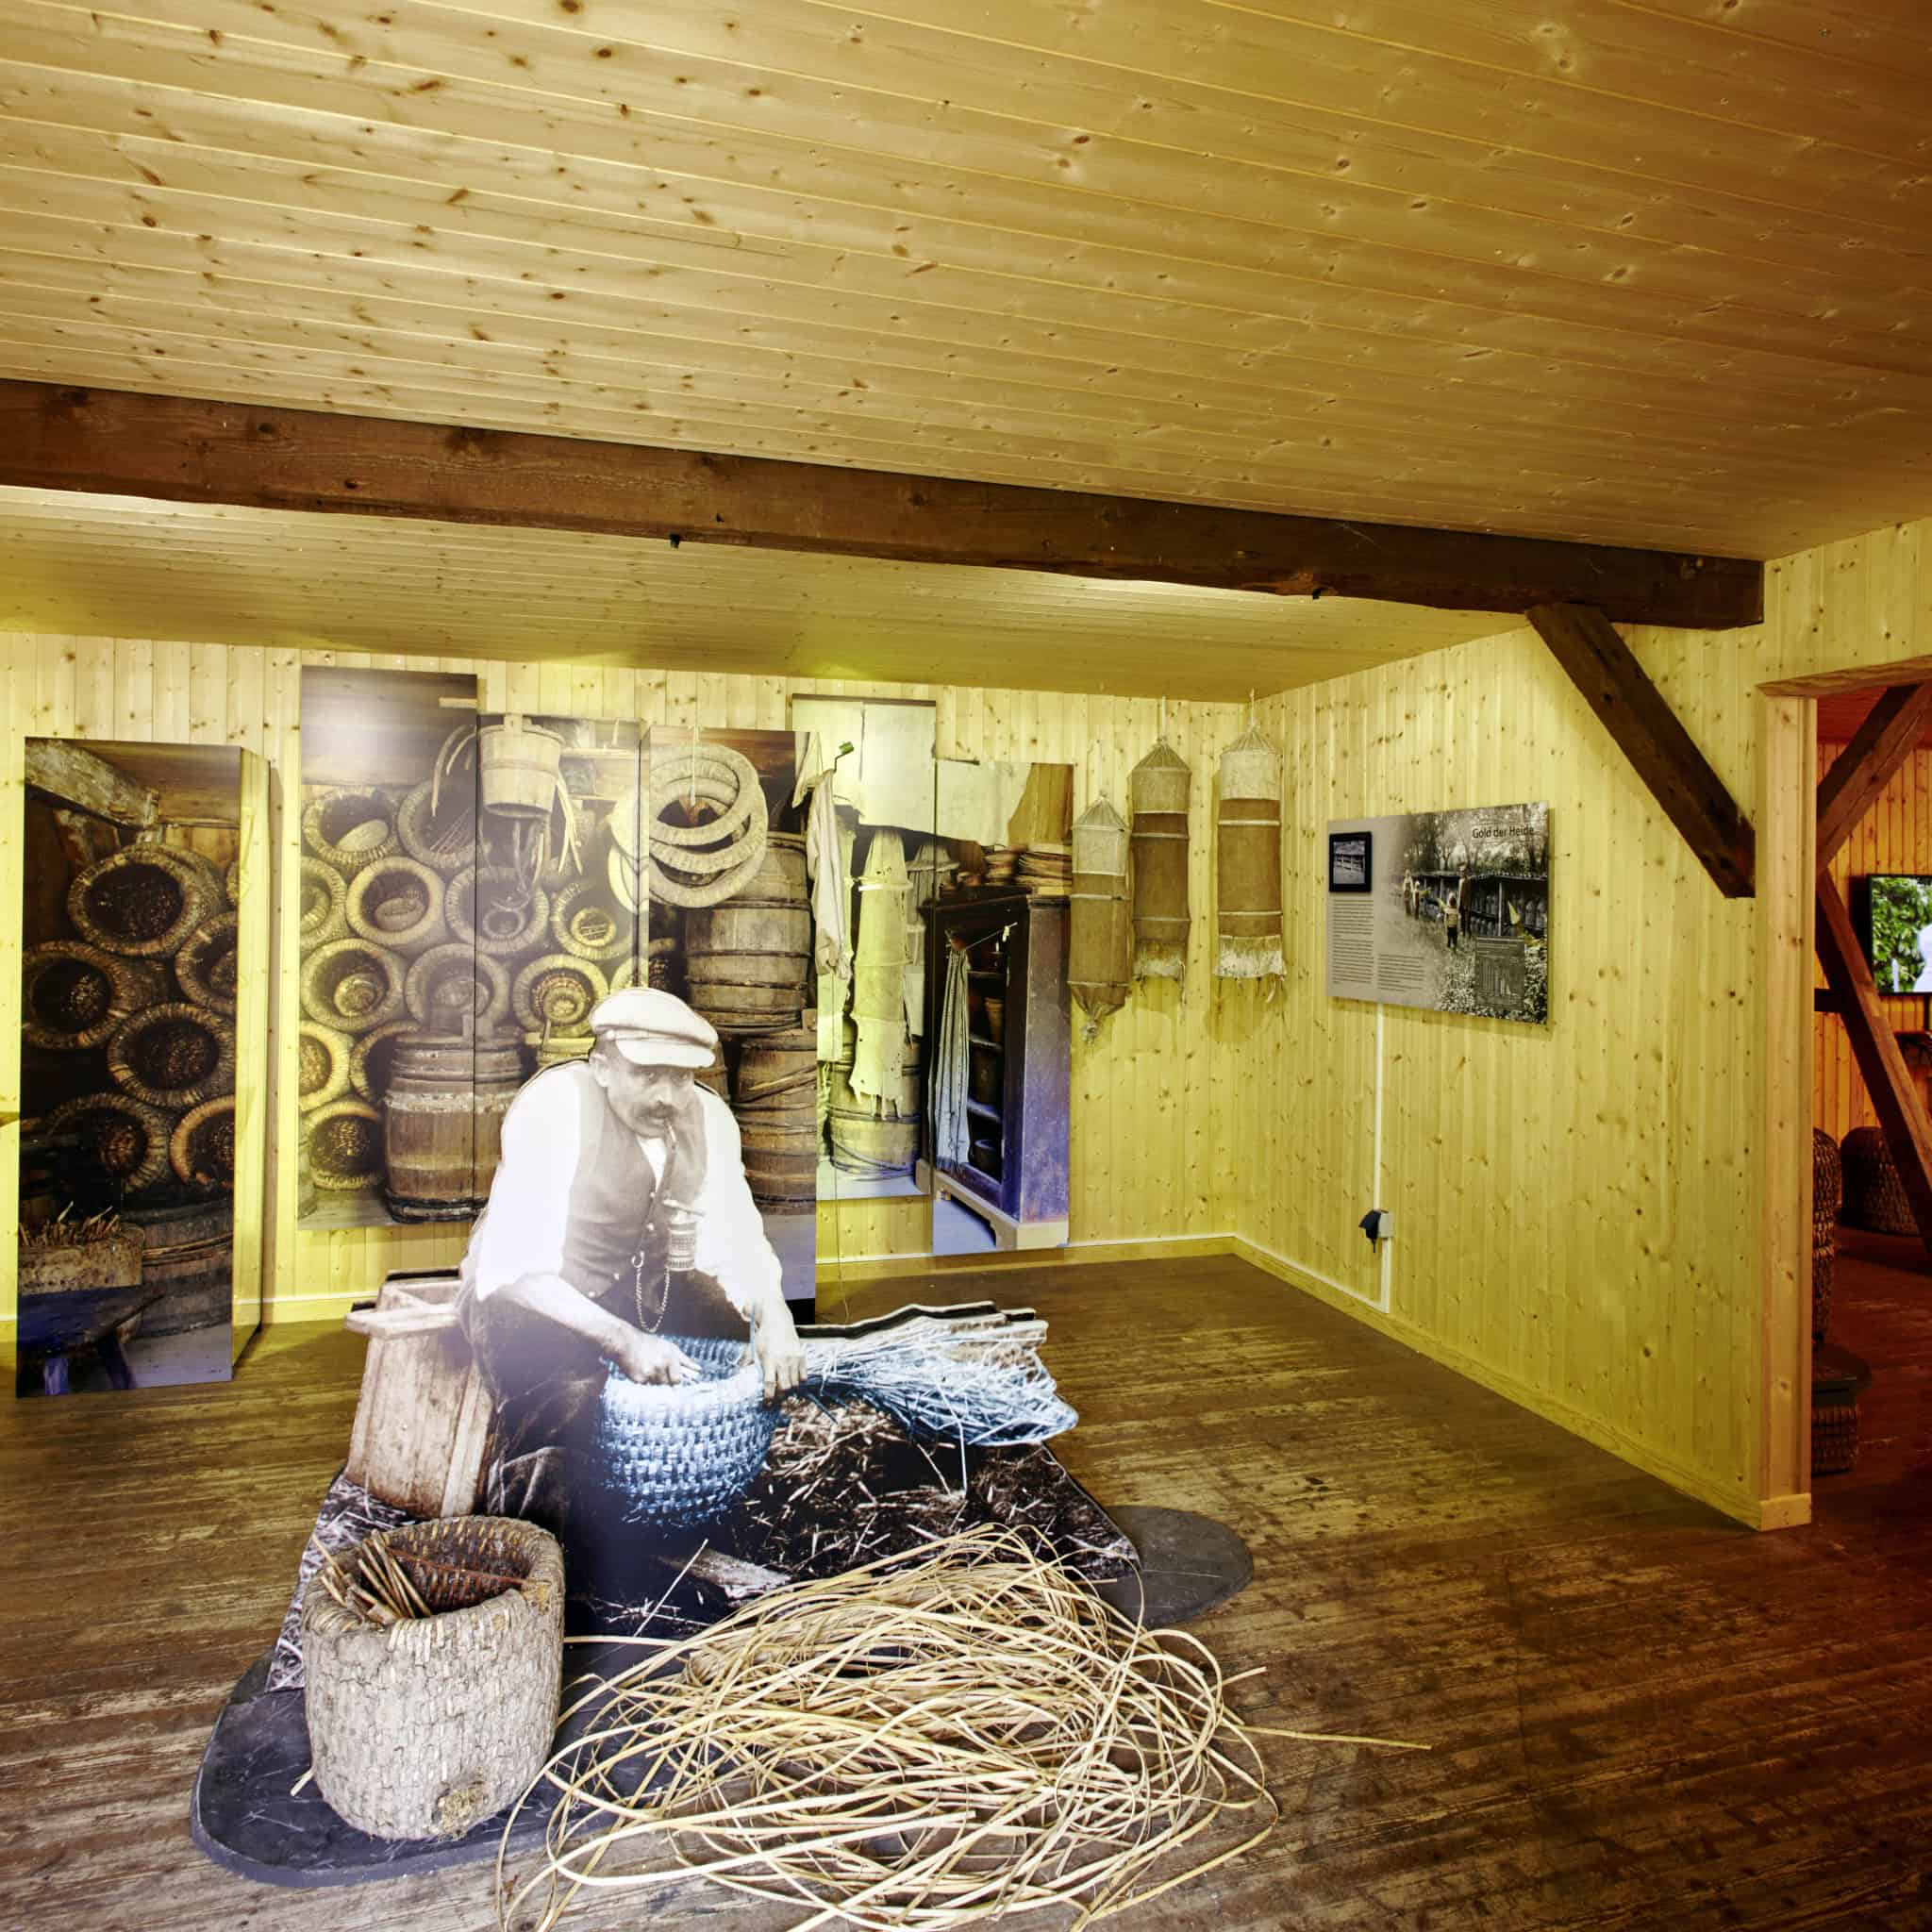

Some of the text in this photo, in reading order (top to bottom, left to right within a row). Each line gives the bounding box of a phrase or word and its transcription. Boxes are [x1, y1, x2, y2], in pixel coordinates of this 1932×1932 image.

[1472, 824, 1534, 839] Gold der Heide
